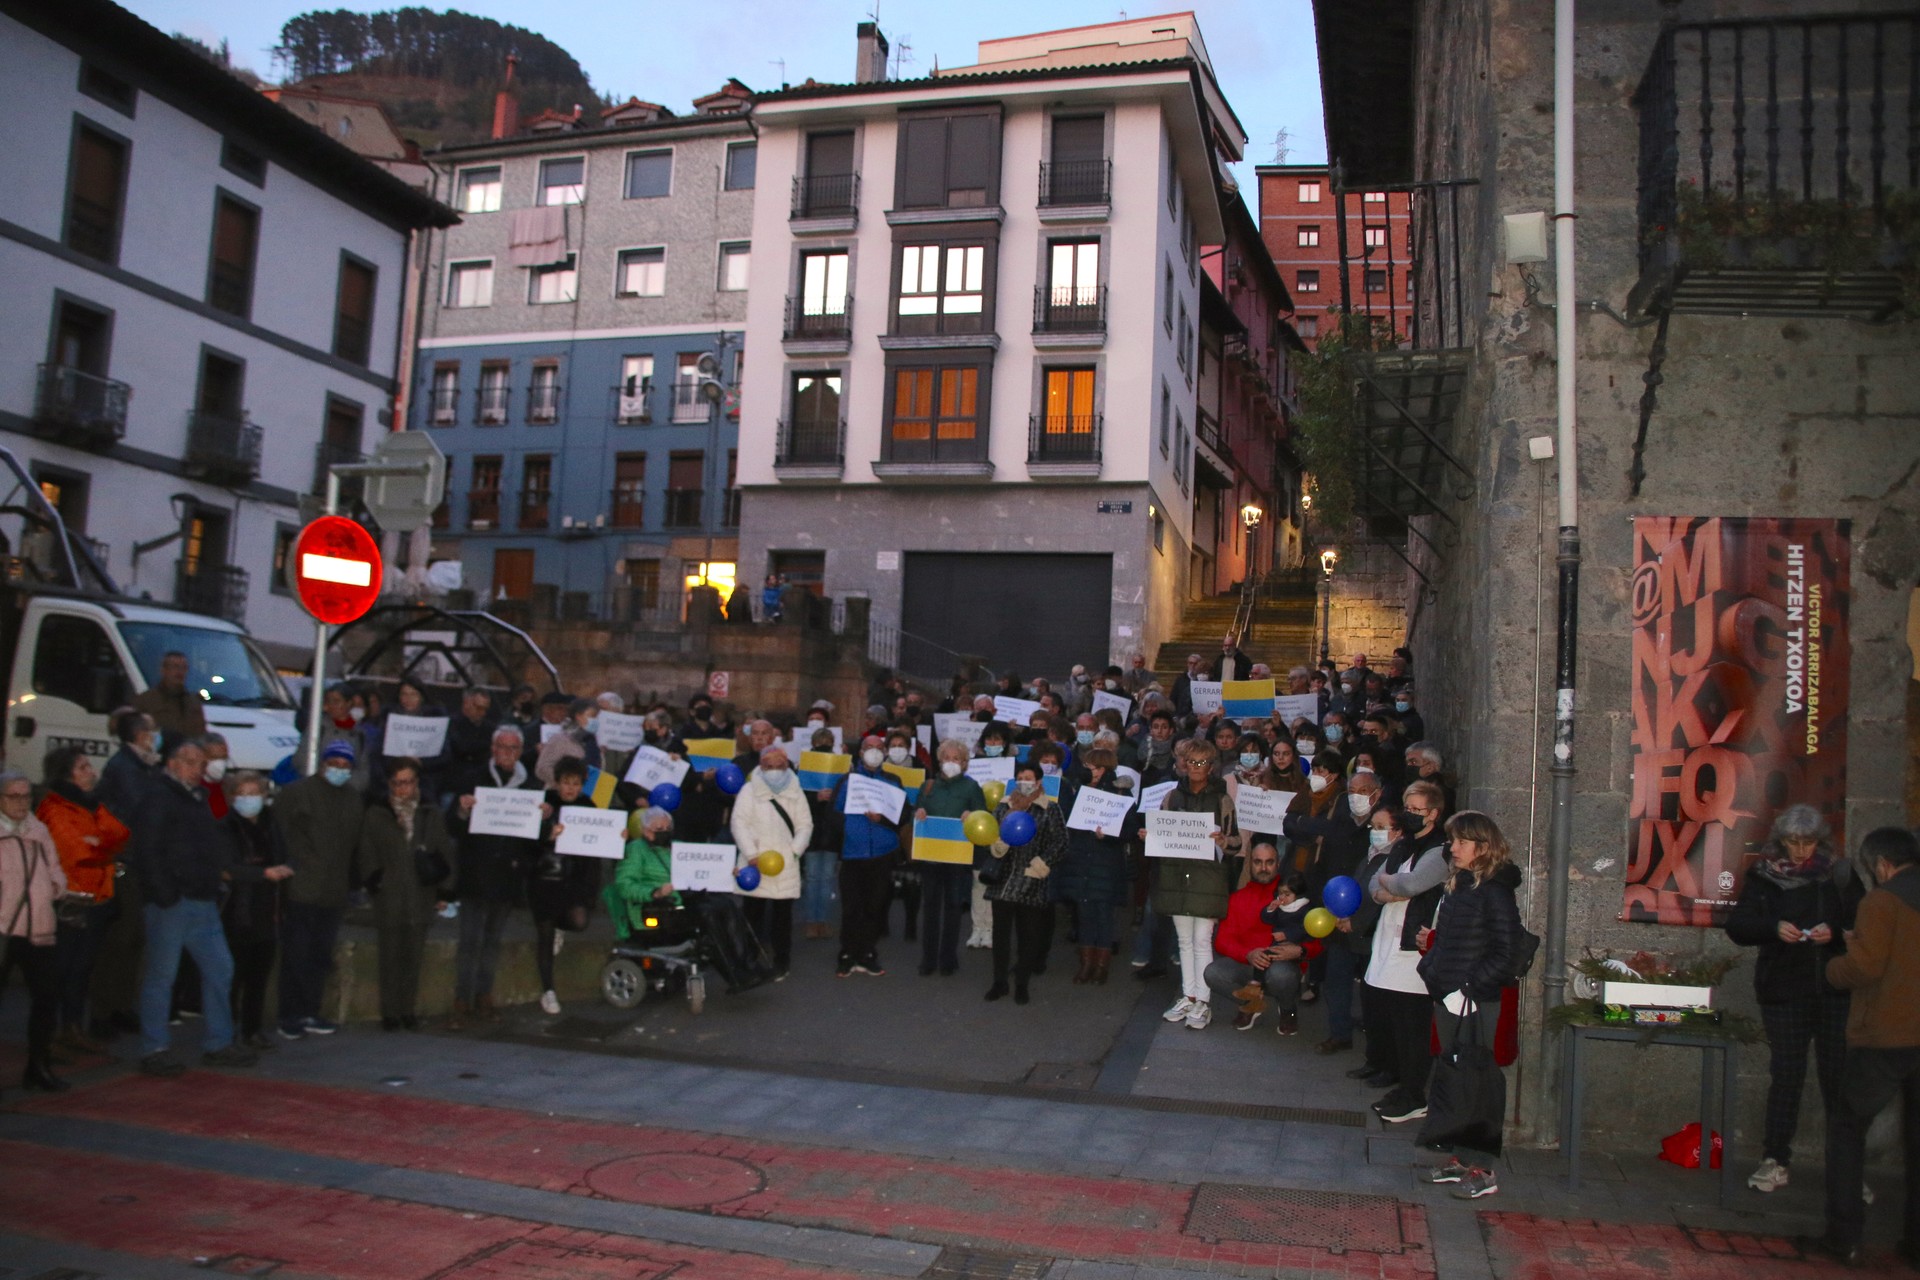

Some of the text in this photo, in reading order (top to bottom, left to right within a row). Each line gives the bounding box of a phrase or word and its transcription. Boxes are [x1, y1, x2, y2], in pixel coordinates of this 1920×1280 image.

[1786, 544, 1804, 714] HITZEN TXOKOA
[1806, 584, 1822, 755] VÍCTOR ARRIZABALAGA
[1194, 687, 1223, 697] GERRARI
[1087, 794, 1105, 805] STOP
[564, 814, 616, 828] GERRARIK
[1156, 817, 1209, 829] STOP PUTIN,
[581, 834, 598, 844] EZ!
[1177, 831, 1206, 840] BAKEAN
[1164, 842, 1201, 851] UKRAINIA!
[677, 851, 725, 863] GERRARIK
[694, 869, 710, 879] EZ!
